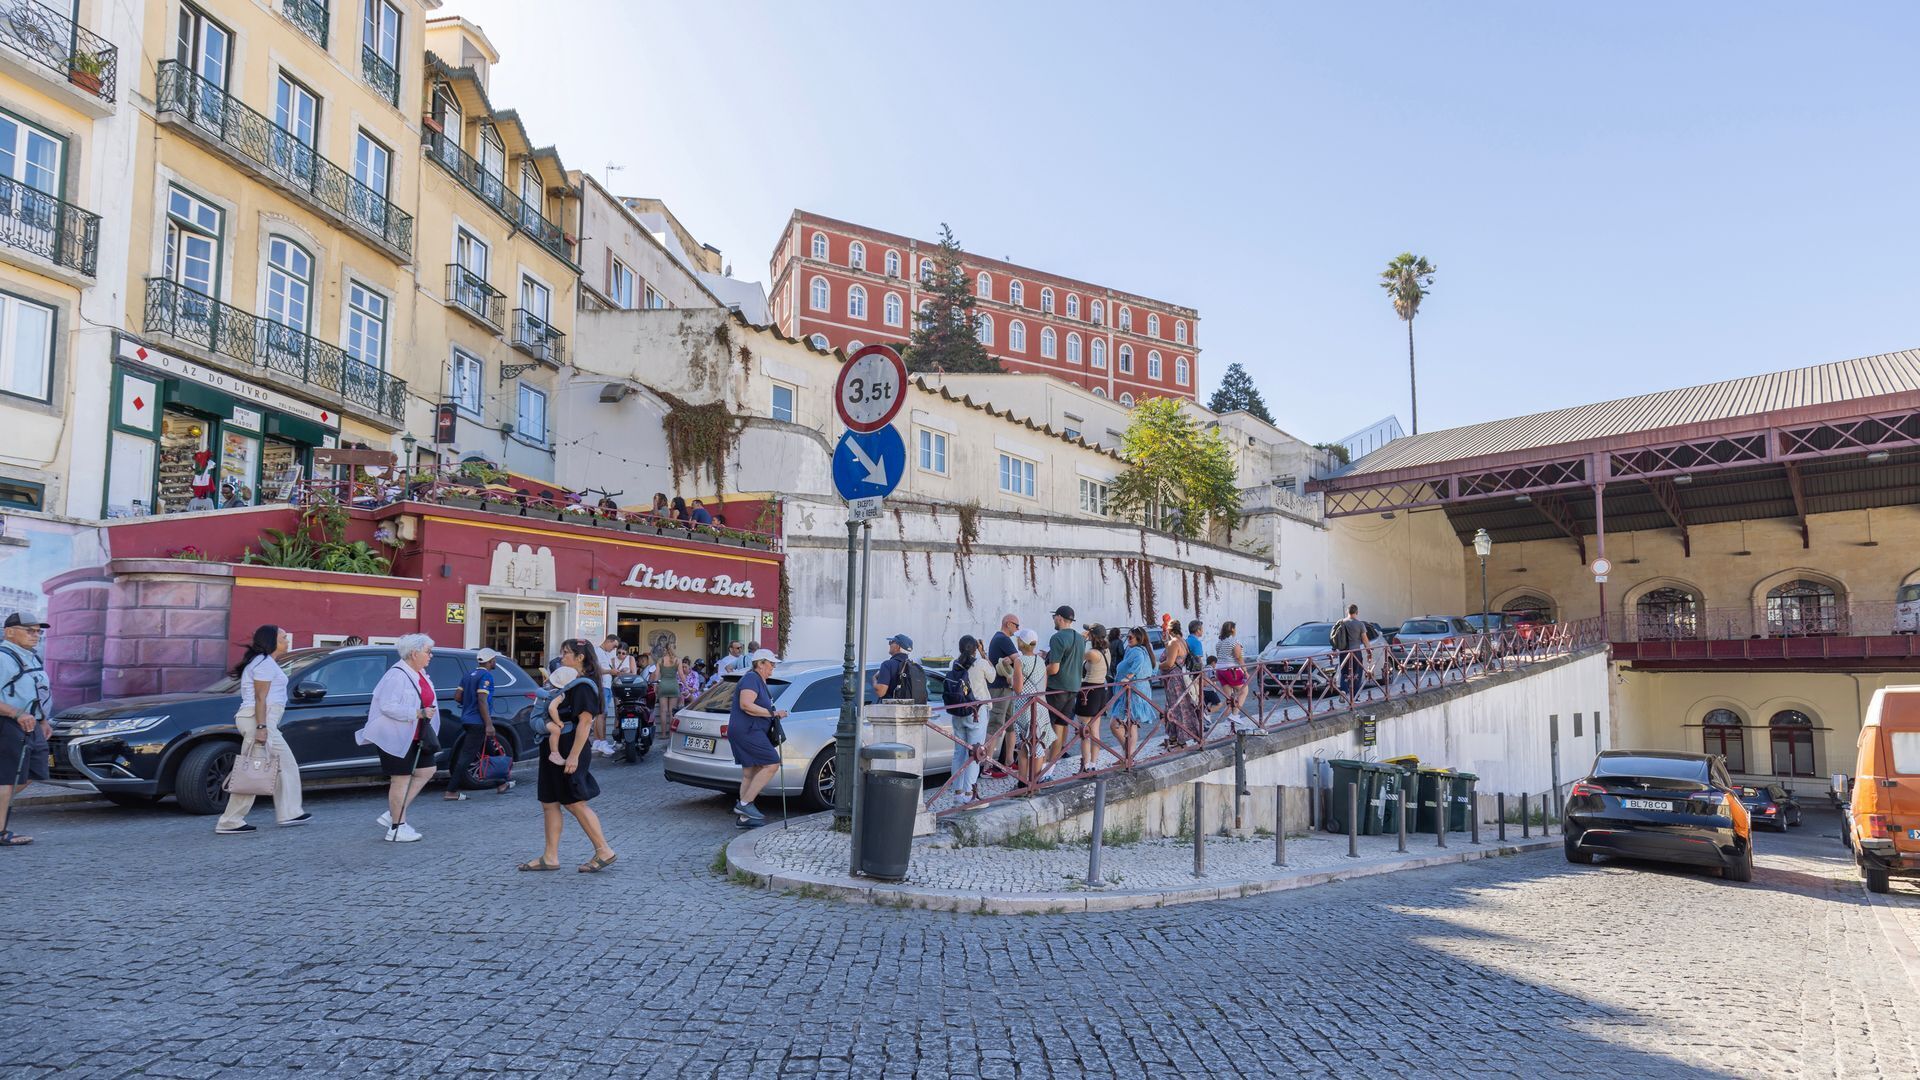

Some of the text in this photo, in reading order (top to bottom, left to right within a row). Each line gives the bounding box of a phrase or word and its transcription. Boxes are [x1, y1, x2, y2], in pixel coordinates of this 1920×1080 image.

[162, 357, 268, 400] O AZ DO LIVRO
[849, 377, 891, 404] 3,5t
[620, 563, 756, 598] Lisboa Bar
